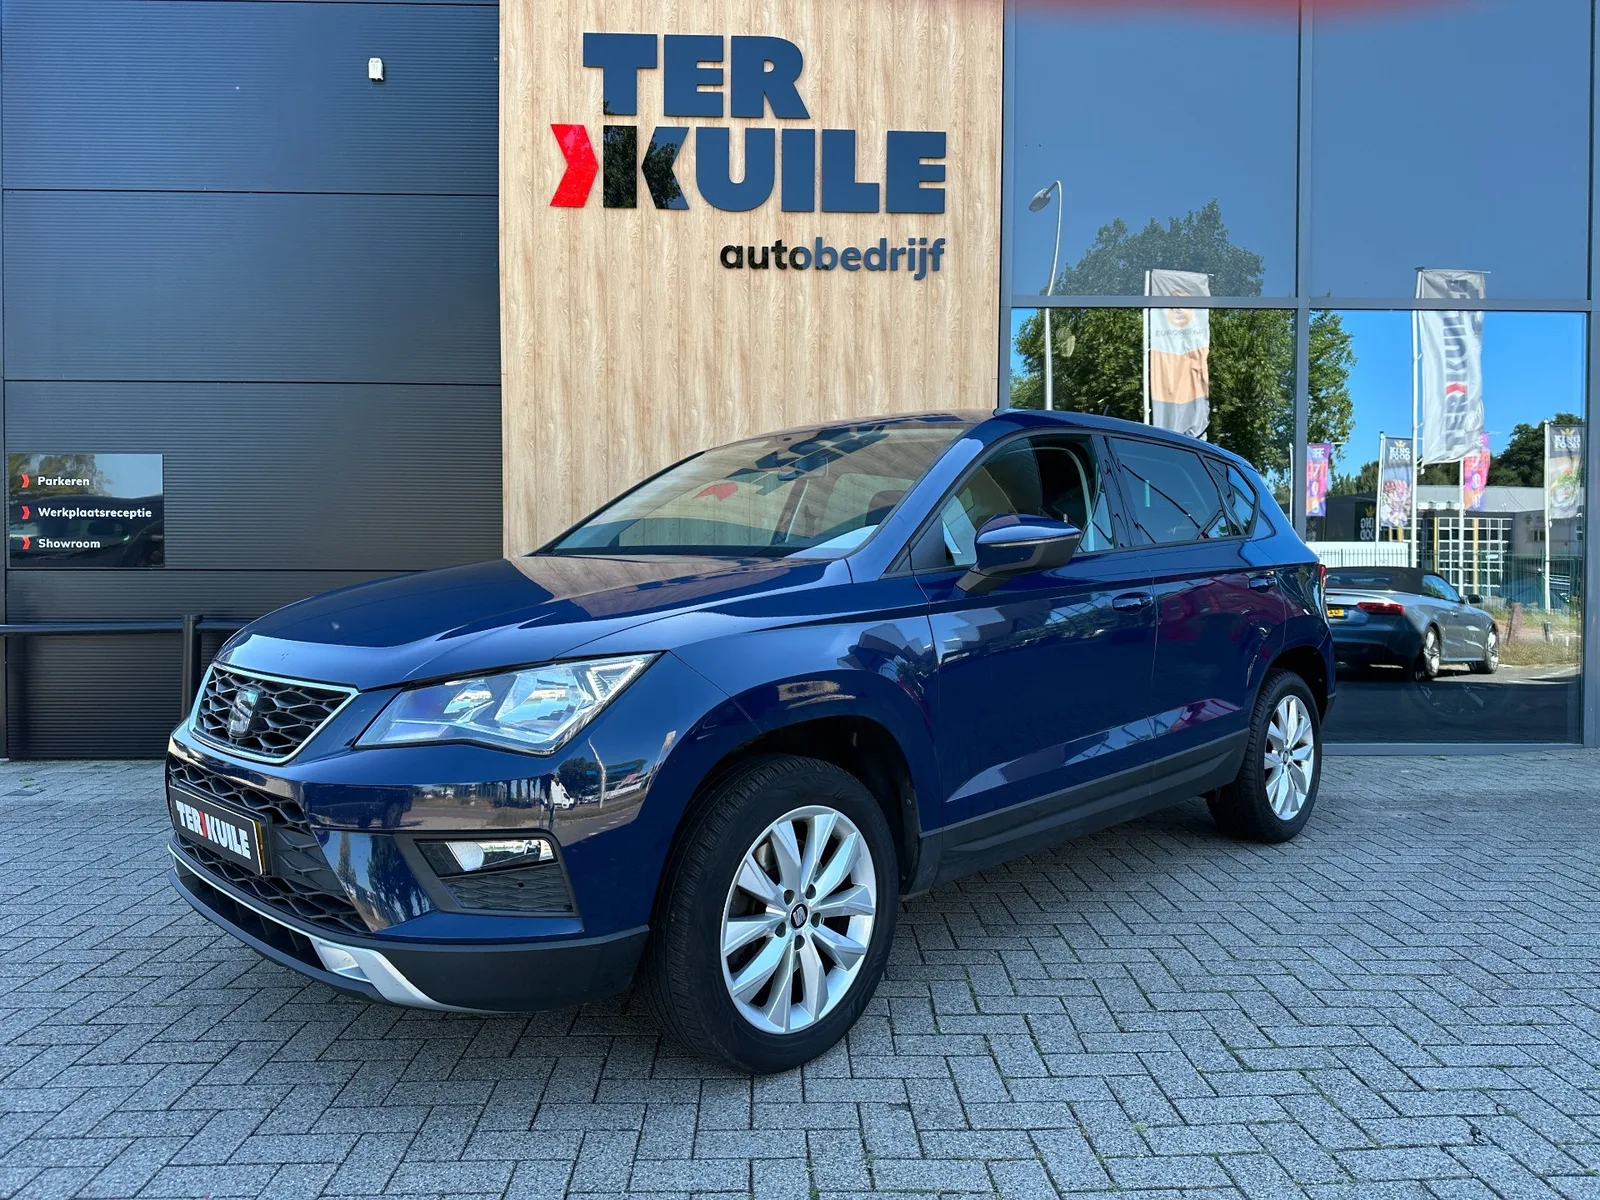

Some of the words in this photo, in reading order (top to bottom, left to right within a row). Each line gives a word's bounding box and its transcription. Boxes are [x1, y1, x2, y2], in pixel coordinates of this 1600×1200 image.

[583, 32, 811, 119] TER
[603, 125, 946, 213] KUILE
[720, 236, 946, 280] autobedrijf
[37, 476, 90, 486] Parkeren
[38, 507, 152, 519] Werkplaatsreceptie
[38, 539, 101, 549] Showroom
[175, 799, 204, 836] TER
[204, 812, 252, 860] KUILE
